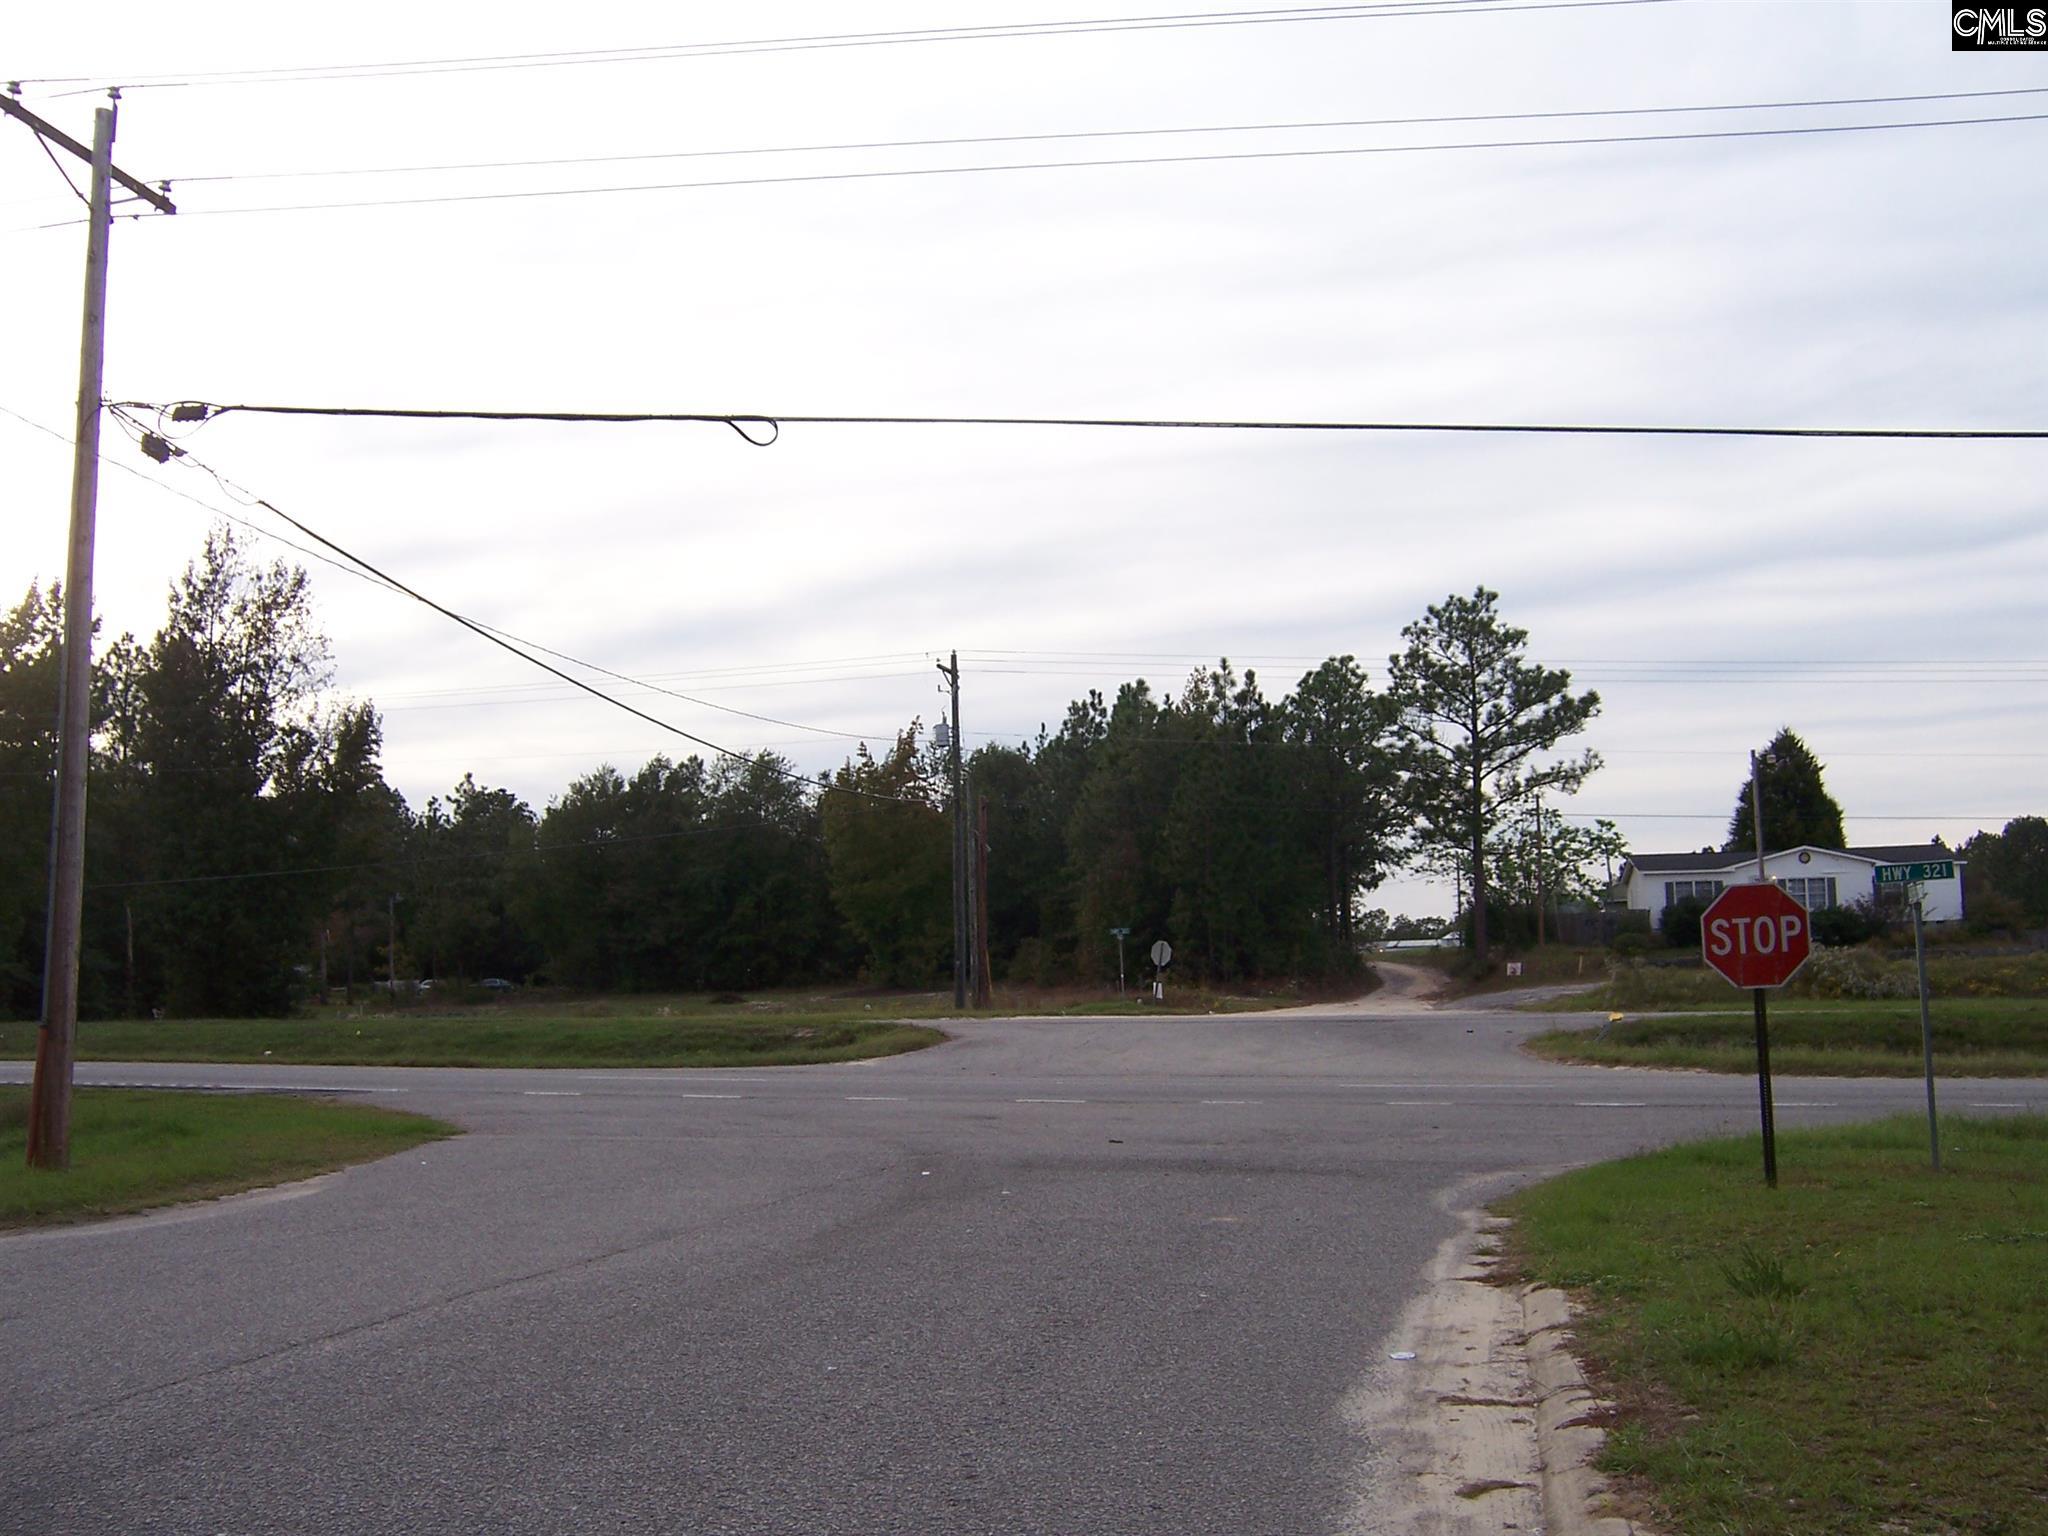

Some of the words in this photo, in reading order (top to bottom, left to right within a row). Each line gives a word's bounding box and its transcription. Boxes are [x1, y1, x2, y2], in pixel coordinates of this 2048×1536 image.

[1882, 866, 1912, 881] HWY
[1922, 863, 1947, 878] 321
[1711, 914, 1802, 956] STOP
